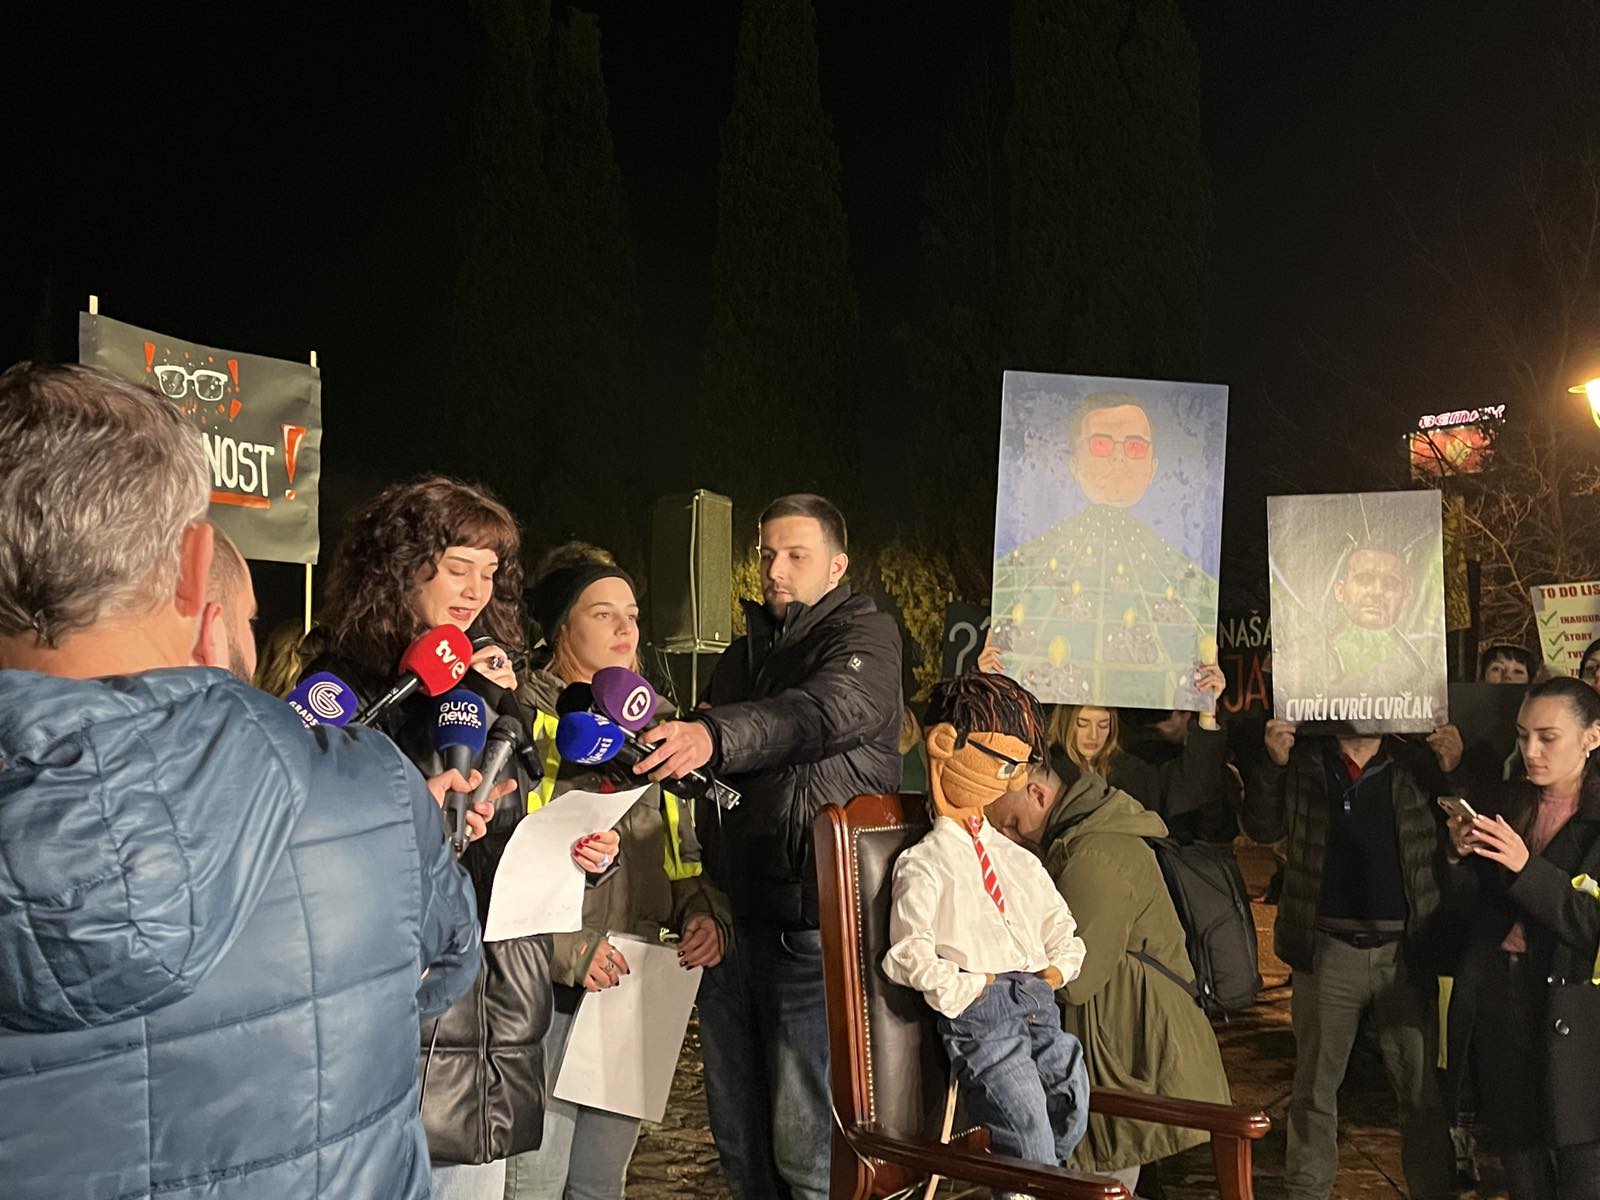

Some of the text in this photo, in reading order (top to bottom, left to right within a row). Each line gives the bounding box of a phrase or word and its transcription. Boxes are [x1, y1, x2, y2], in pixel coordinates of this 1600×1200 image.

[1539, 587, 1556, 599] TO
[1559, 585, 1577, 597] DO
[1563, 632, 1592, 642] STORY
[440, 701, 478, 714] euro
[1286, 690, 1433, 721] CVRČI CVRČI CVRČAK
